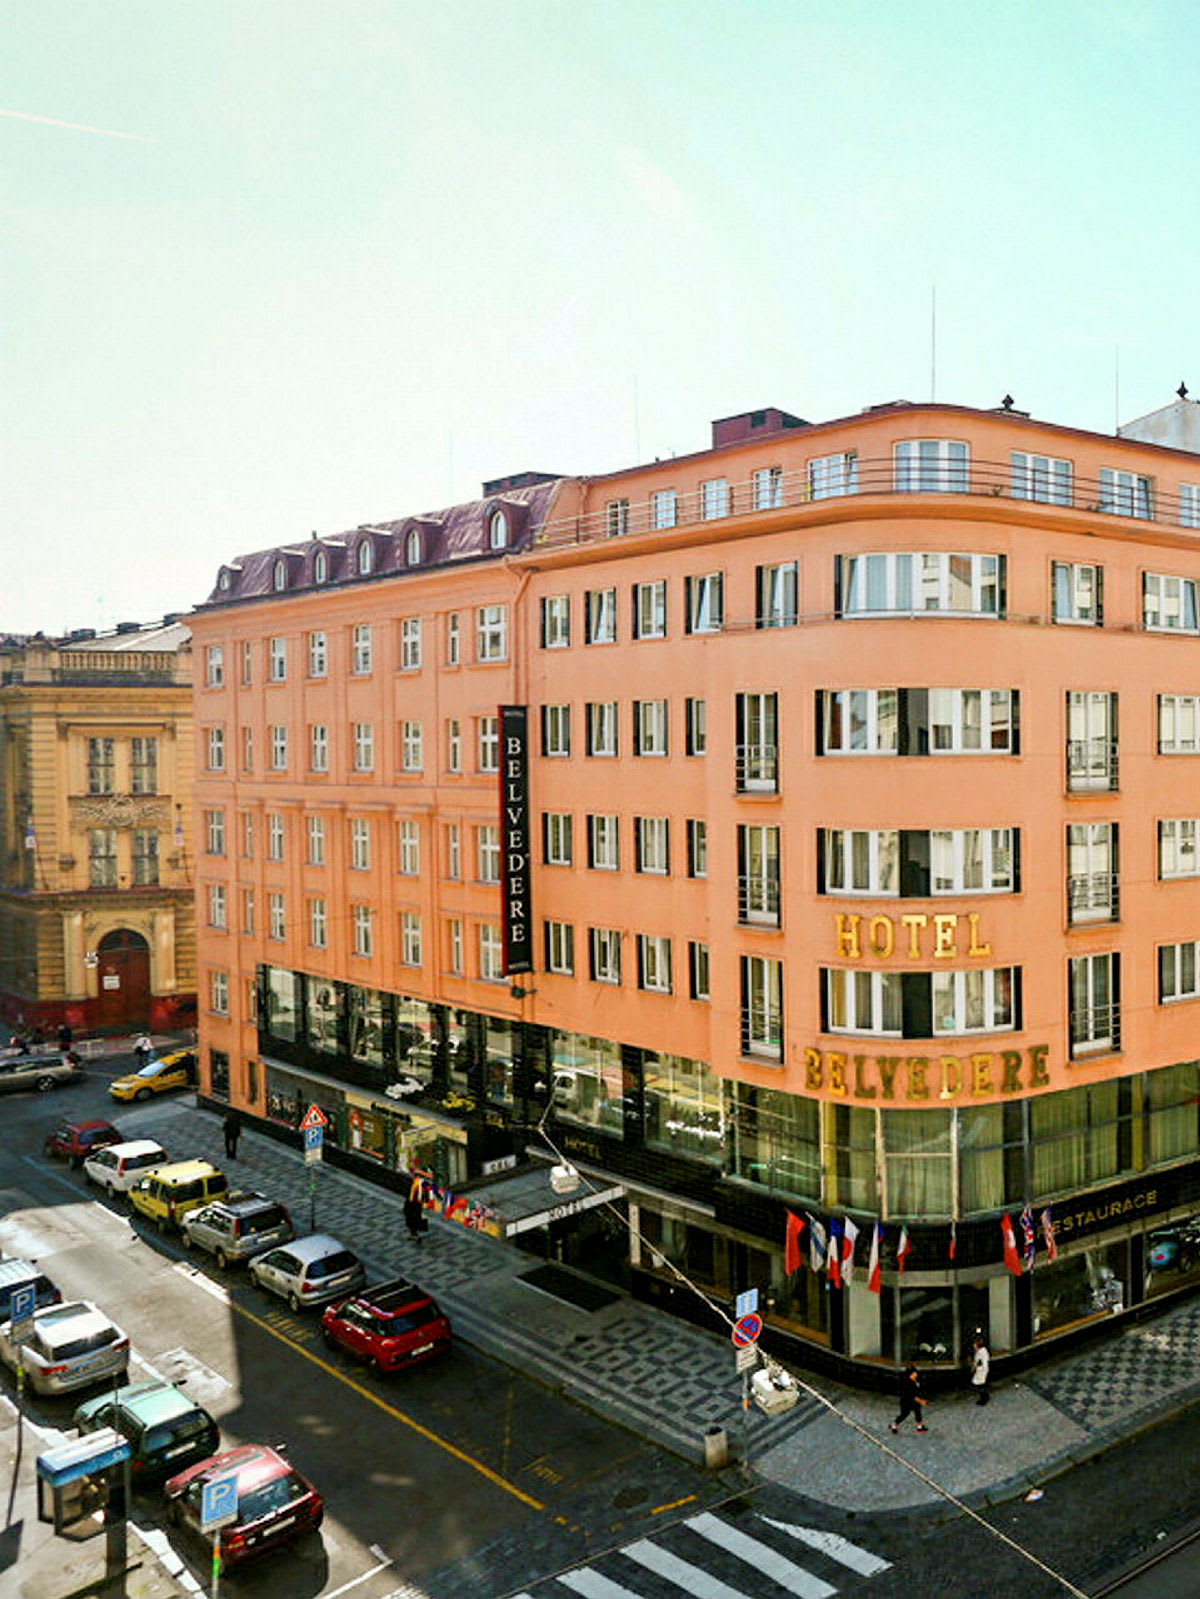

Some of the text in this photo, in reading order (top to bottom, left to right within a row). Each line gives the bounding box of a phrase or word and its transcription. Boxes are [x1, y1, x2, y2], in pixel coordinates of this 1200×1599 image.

[507, 737, 525, 942] BELVEDERE
[834, 914, 991, 958] HOTEL
[803, 1044, 1050, 1101] BELVEDERE
[16, 1293, 31, 1314] P
[210, 1484, 231, 1510] P
